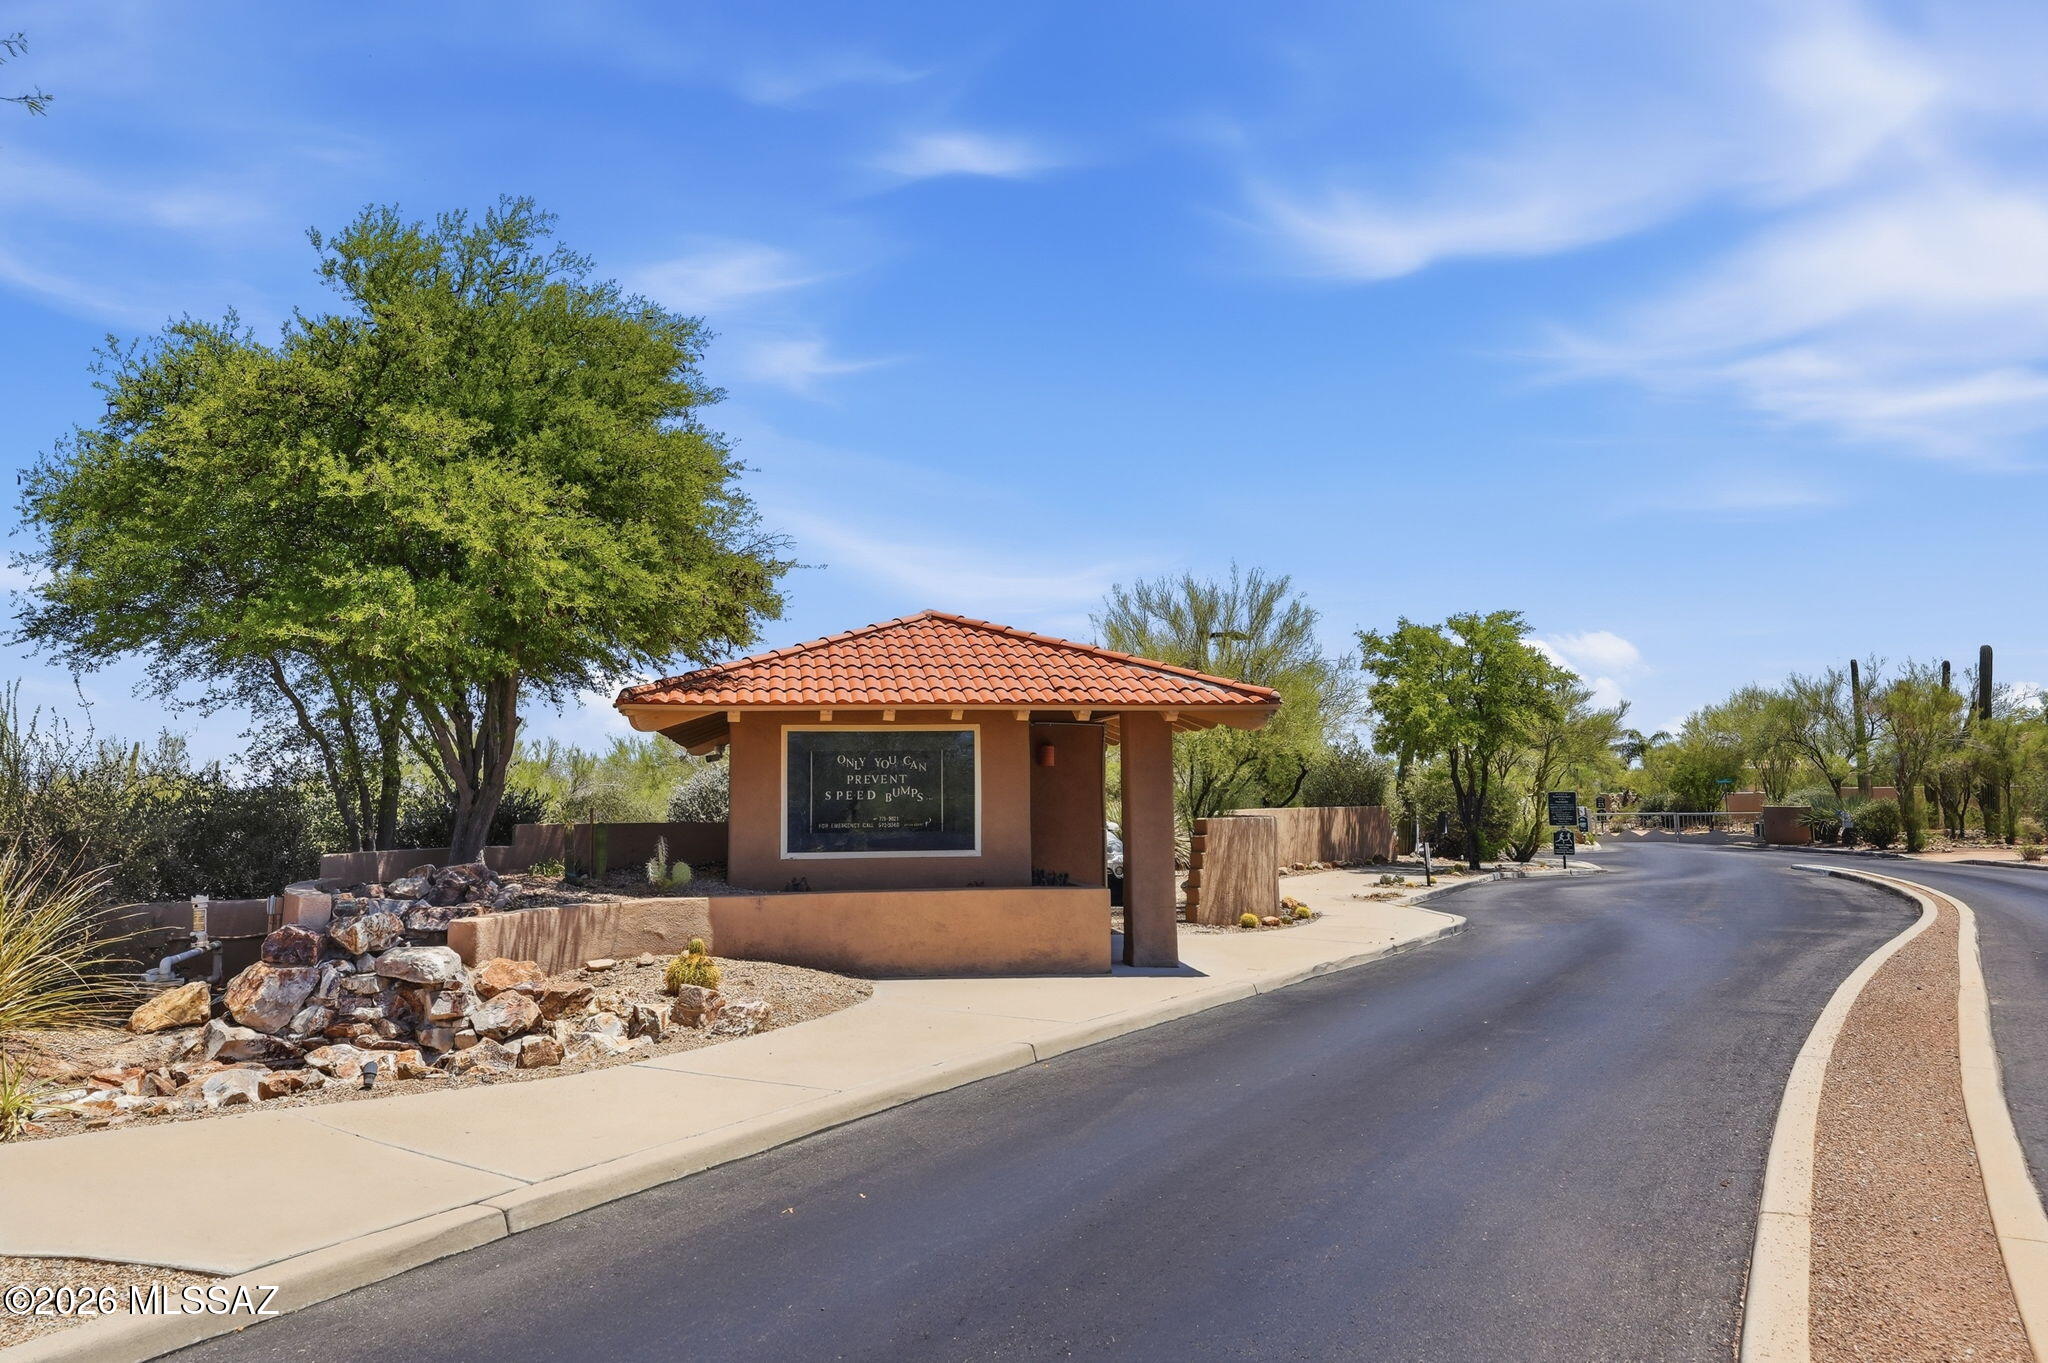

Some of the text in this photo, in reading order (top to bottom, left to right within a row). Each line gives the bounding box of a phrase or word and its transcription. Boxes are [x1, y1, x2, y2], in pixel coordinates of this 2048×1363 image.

[837, 754, 927, 772] ONLY YOU CAN
[847, 774, 907, 784] PREVENT
[825, 790, 876, 800] SPEED
